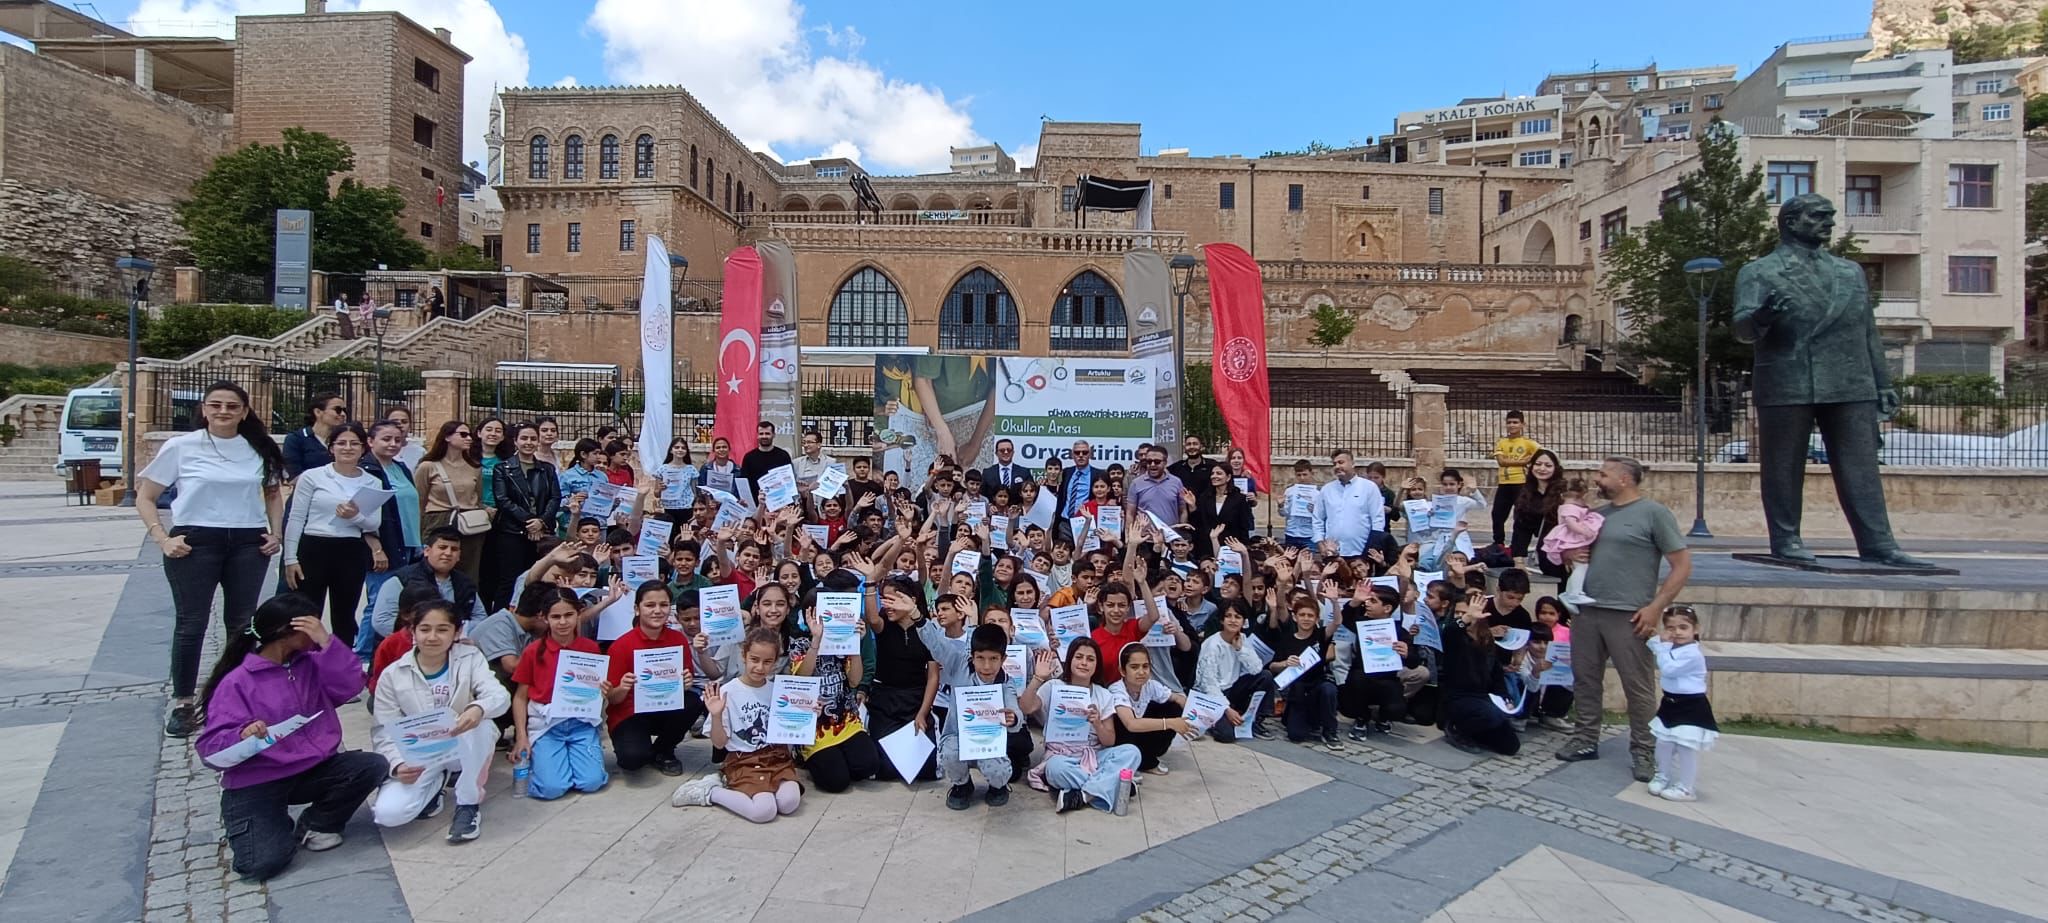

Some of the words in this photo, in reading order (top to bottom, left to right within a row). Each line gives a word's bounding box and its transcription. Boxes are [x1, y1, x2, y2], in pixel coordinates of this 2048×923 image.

[1439, 107, 1477, 121] KALE
[1484, 100, 1536, 117] KONAK
[1000, 418, 1045, 433] Okullar
[1048, 419, 1081, 434] Arası
